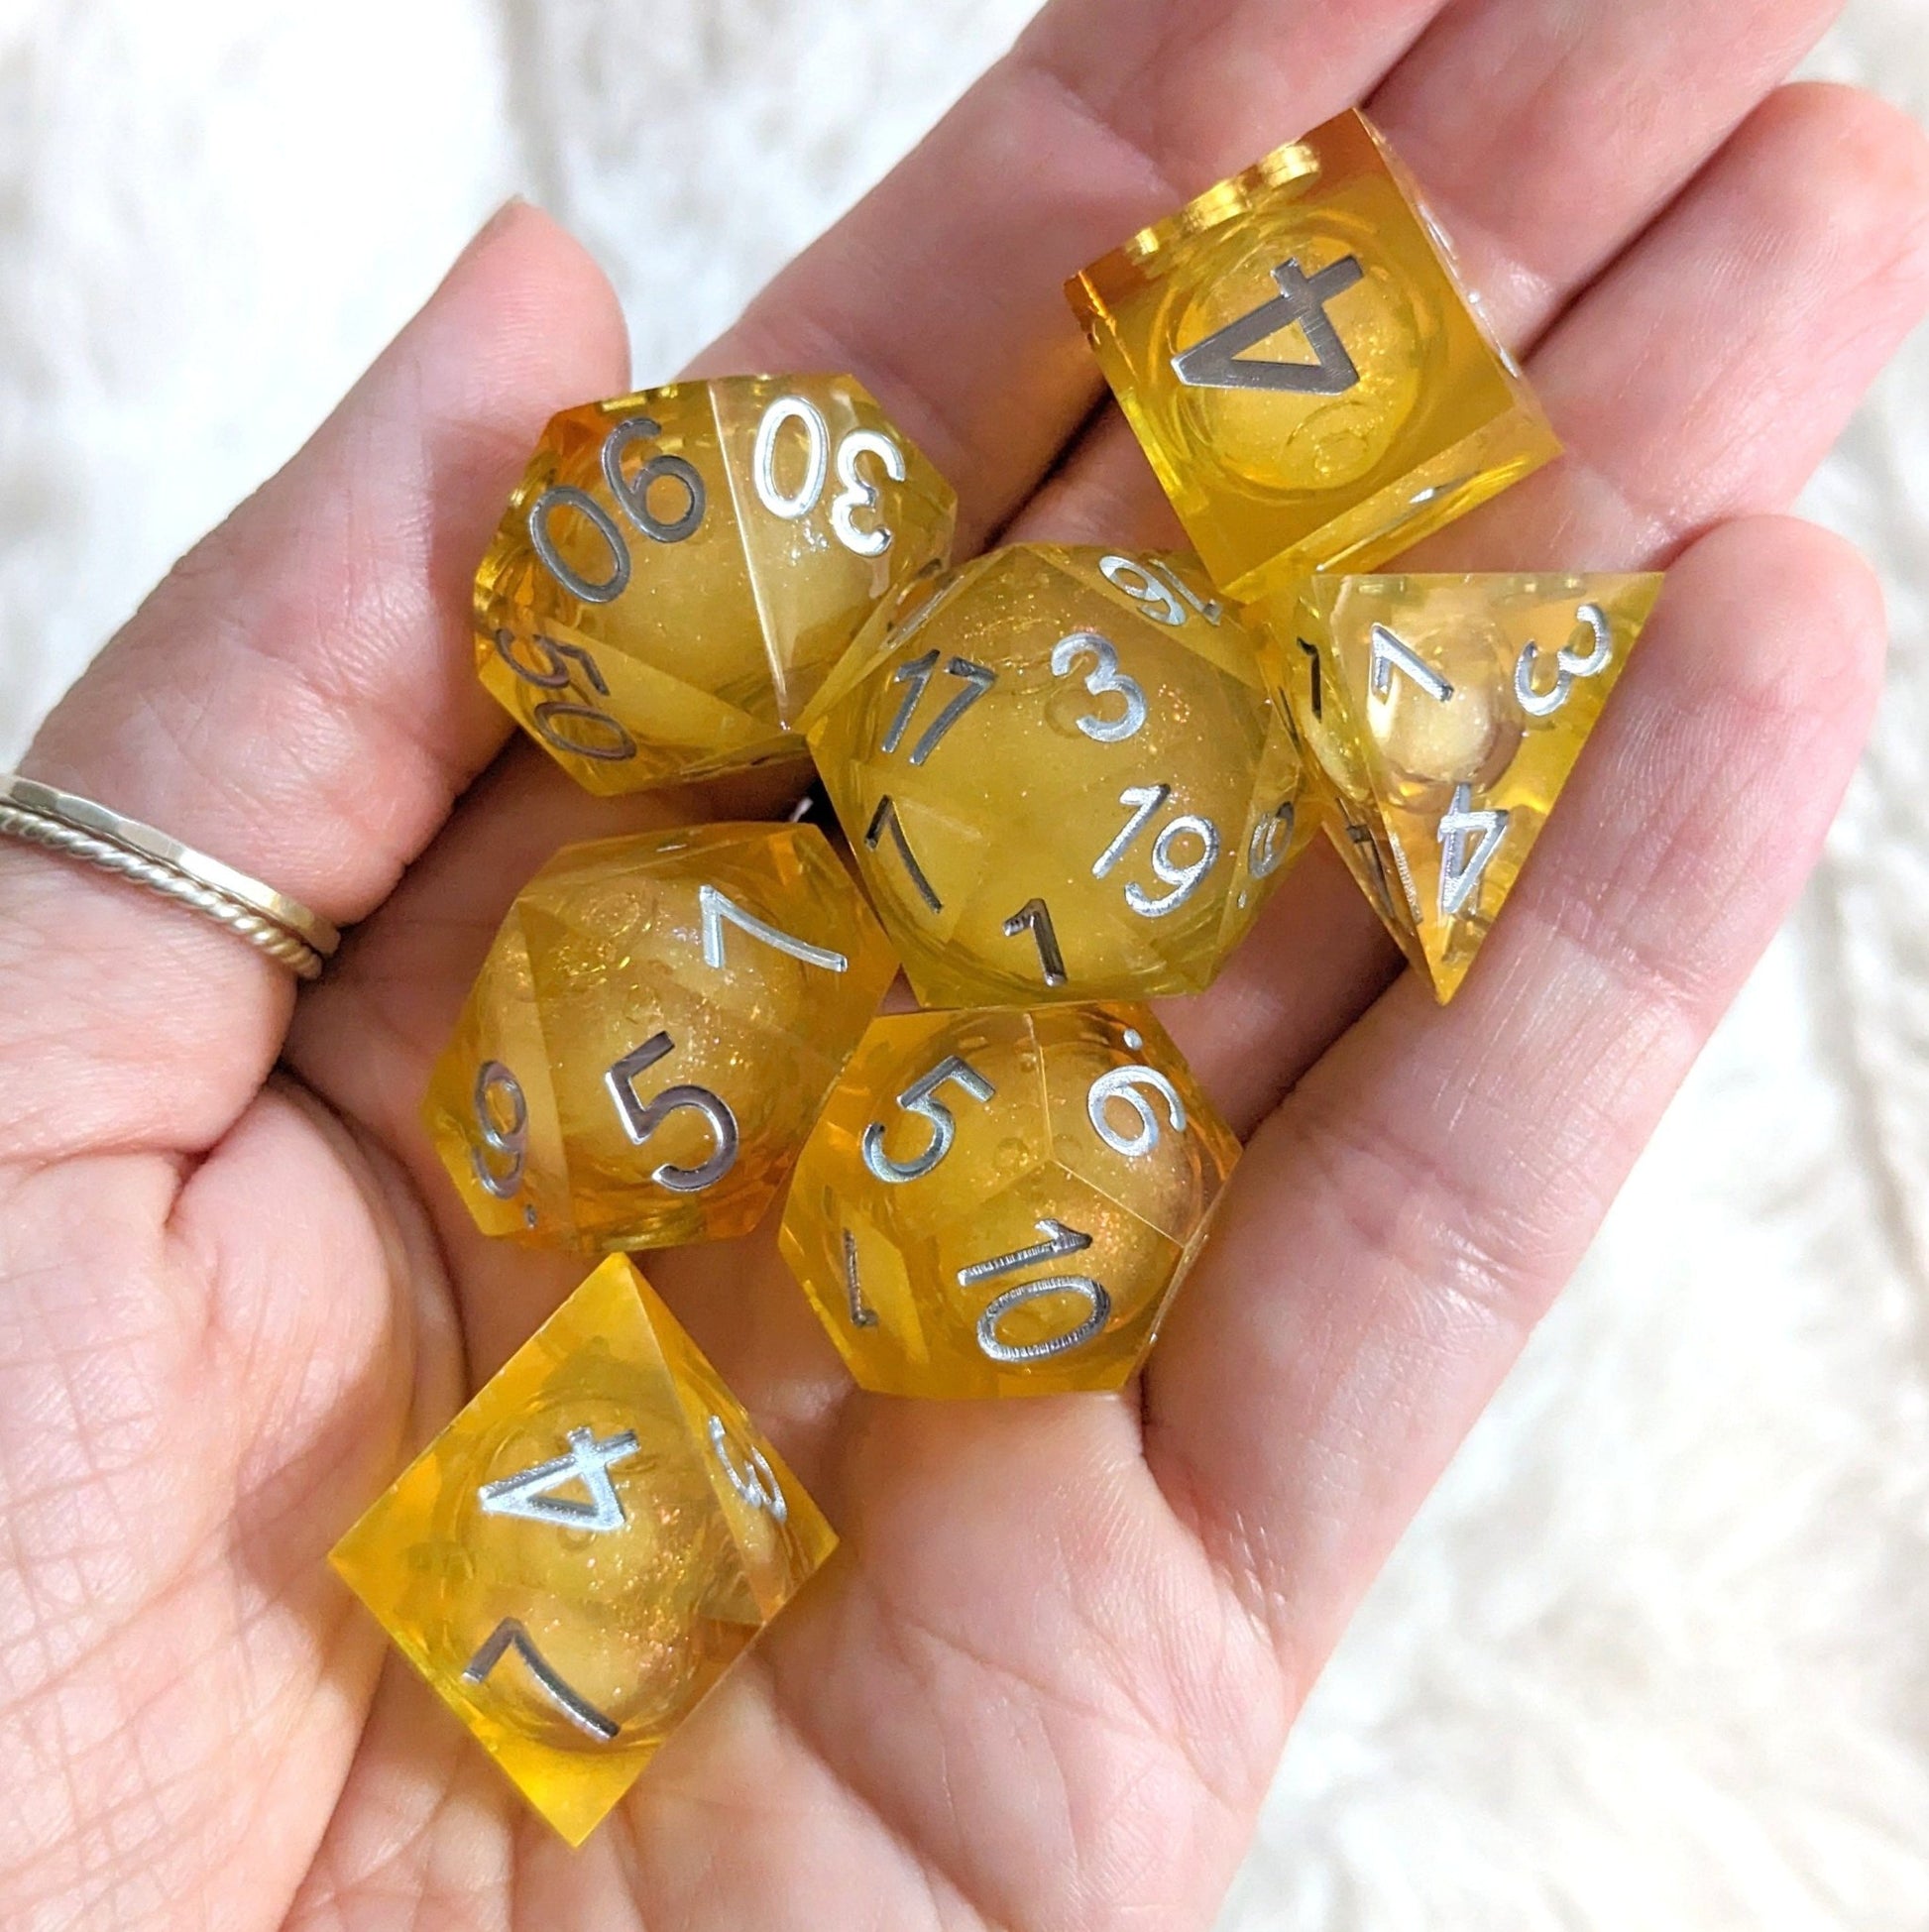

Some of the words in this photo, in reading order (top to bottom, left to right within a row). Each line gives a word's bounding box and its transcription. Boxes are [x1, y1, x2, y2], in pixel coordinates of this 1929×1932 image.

[1171, 255, 1364, 396] 4
[529, 417, 706, 603] 90
[754, 397, 906, 557] 30
[497, 627, 637, 760] 50
[882, 649, 999, 766] 17
[1051, 631, 1149, 743] 3
[1515, 604, 1613, 716] 3
[1092, 783, 1220, 918] 19
[1438, 781, 1511, 914] 4
[699, 885, 850, 972] 7
[605, 1030, 739, 1193] 5
[862, 1055, 995, 1184] 5
[958, 1218, 1111, 1363] 10
[479, 1426, 640, 1533] 4
